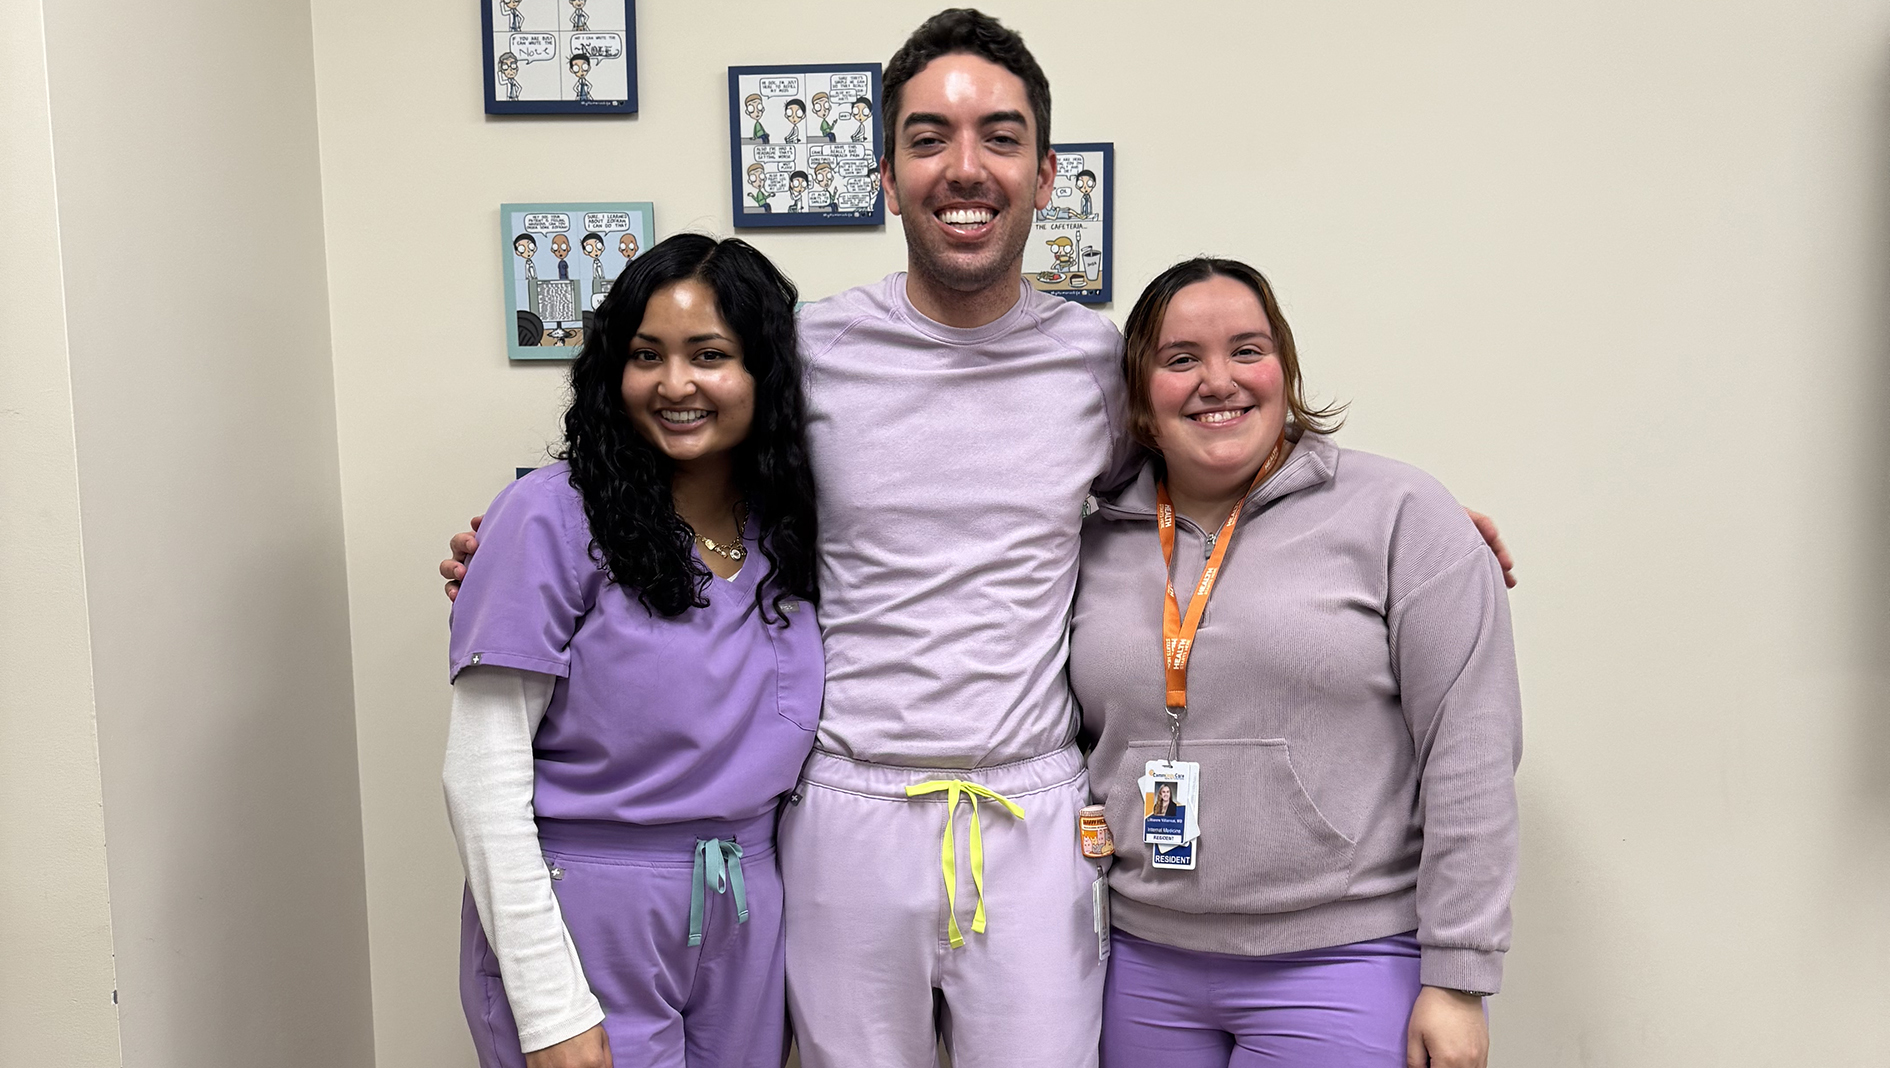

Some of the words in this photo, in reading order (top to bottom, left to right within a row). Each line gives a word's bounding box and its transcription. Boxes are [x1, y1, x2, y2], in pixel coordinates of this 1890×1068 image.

[1197, 567, 1214, 595] HEALTH
[1173, 638, 1187, 670] HEALTH
[1155, 854, 1190, 864] RESIDENT
